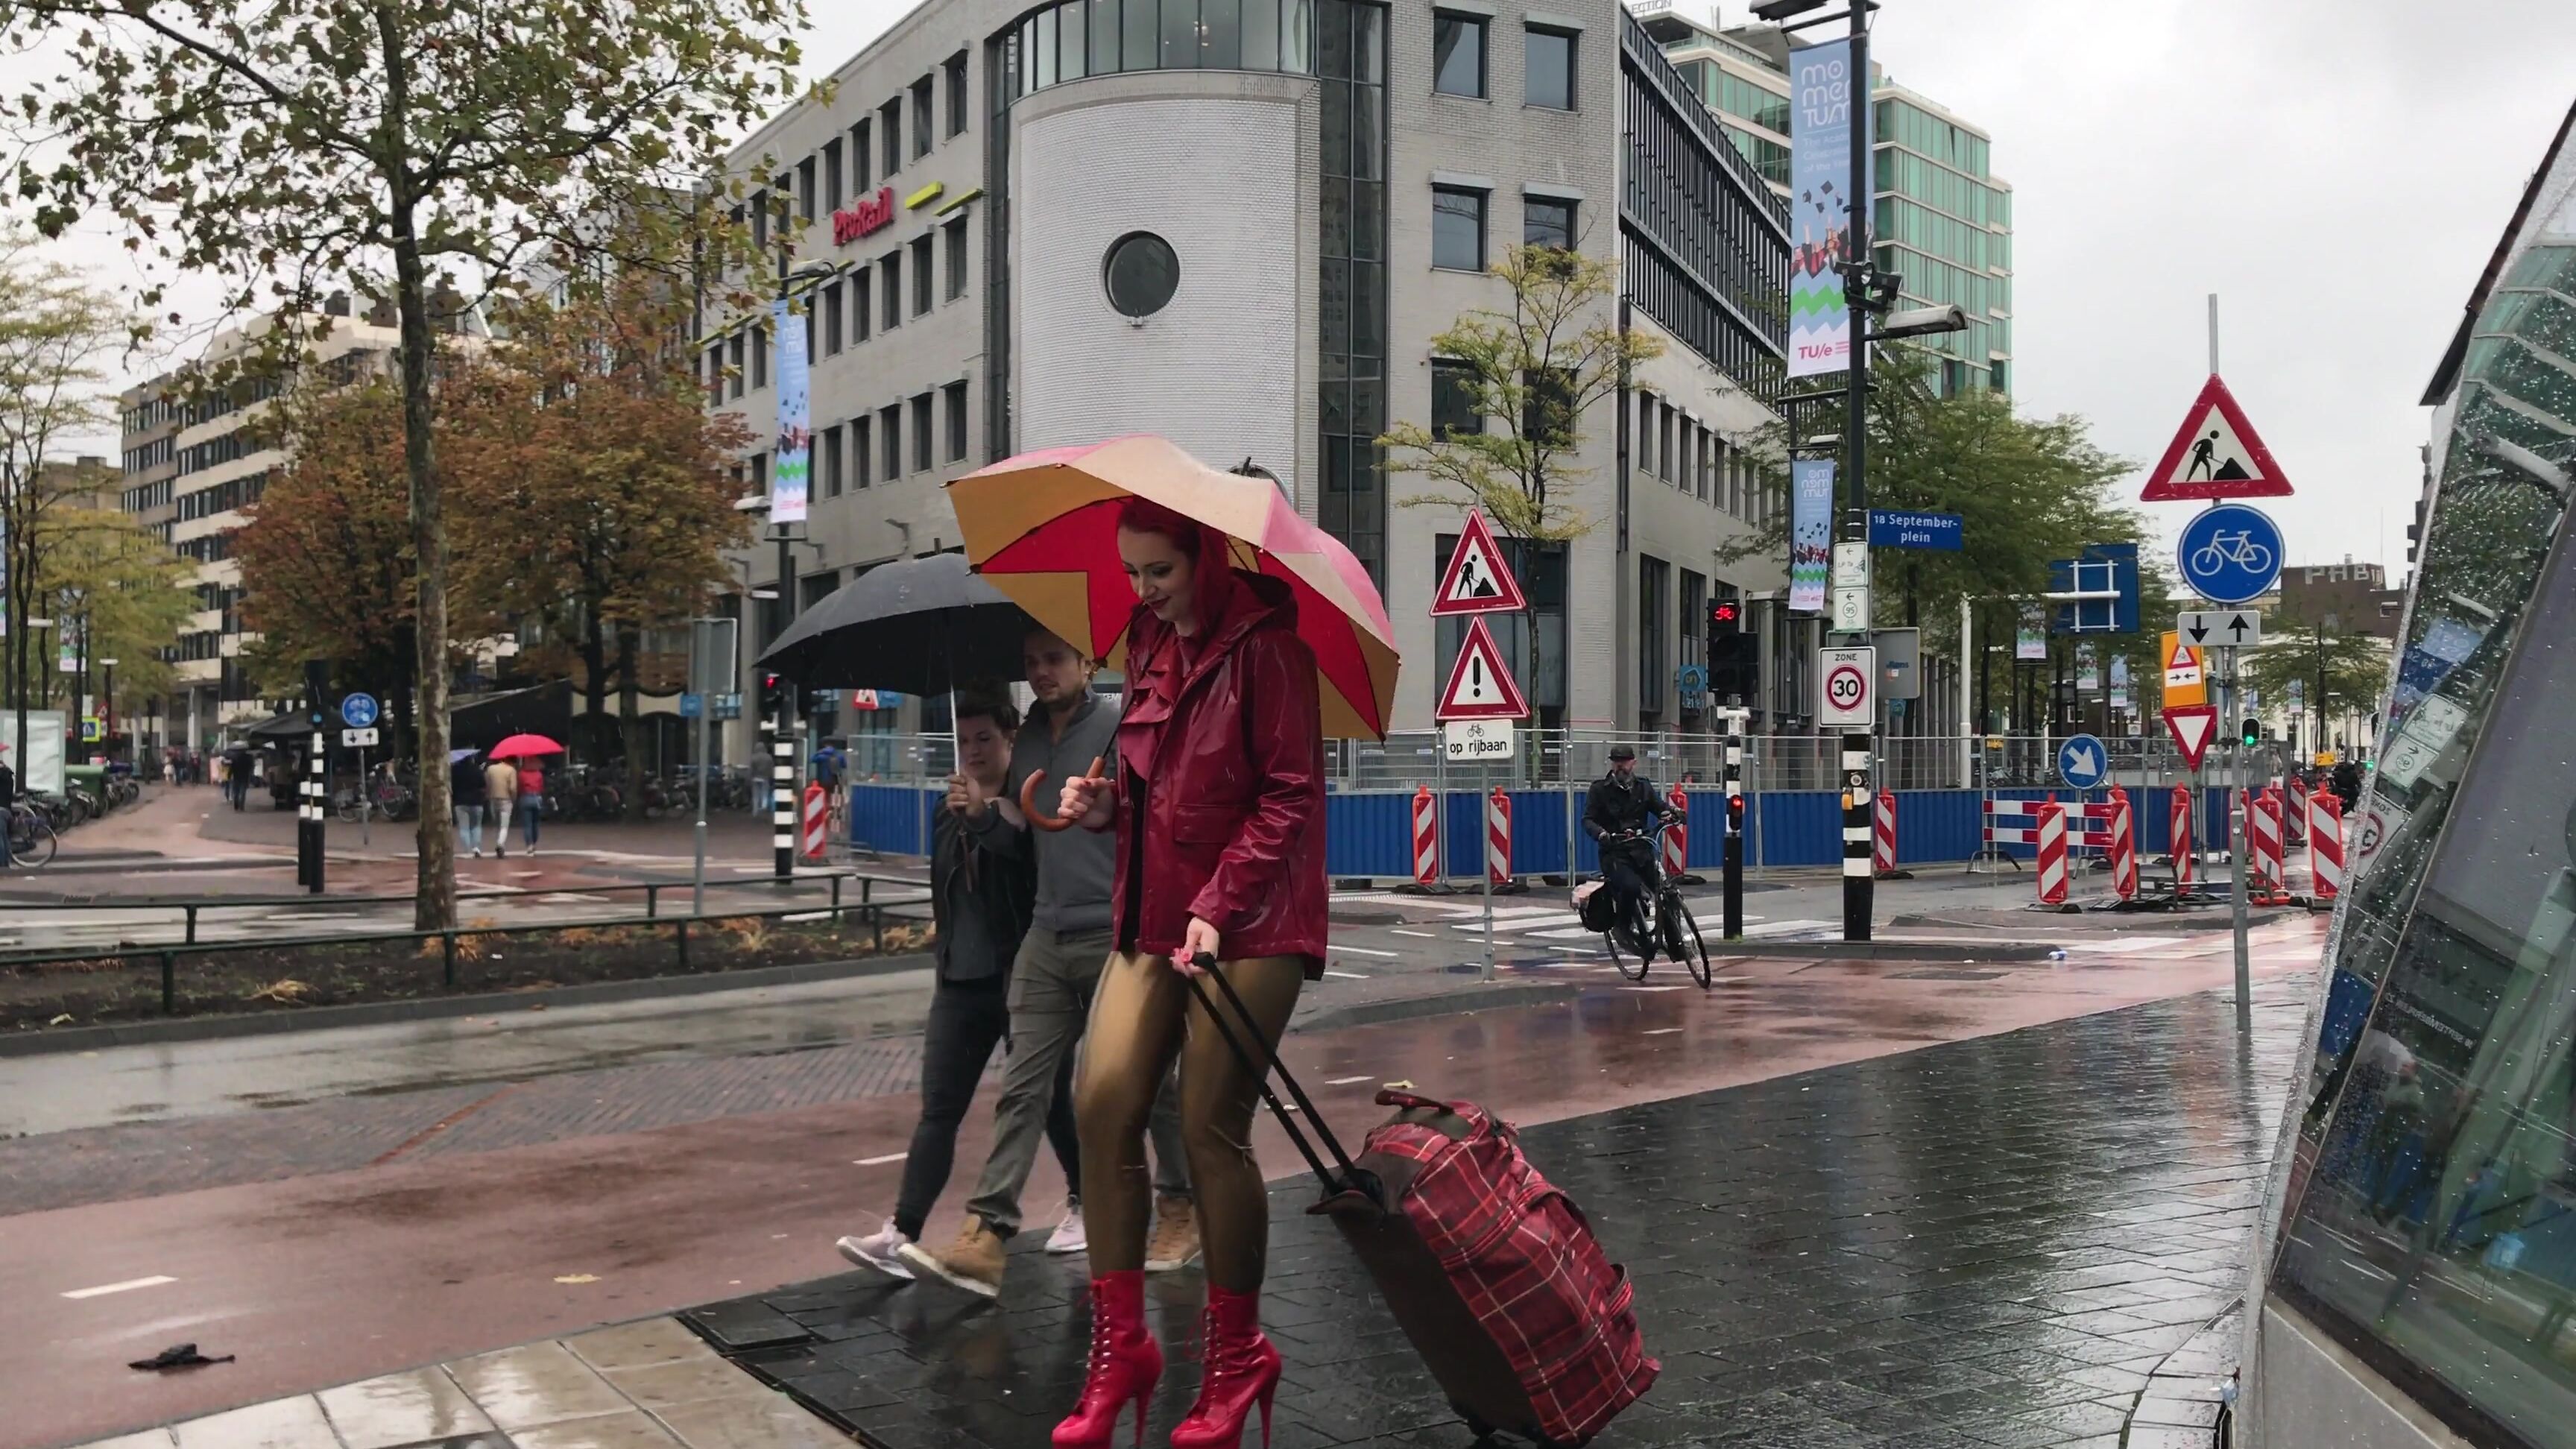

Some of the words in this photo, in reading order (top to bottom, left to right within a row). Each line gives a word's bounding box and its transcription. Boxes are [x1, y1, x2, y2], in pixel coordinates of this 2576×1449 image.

[833, 186, 892, 246] ProRail
[1798, 343, 1833, 359] TU/e
[1874, 514, 1885, 524] 18
[1889, 514, 1958, 528] September-
[1901, 530, 1931, 544] plein
[1833, 679, 1858, 697] 30
[1450, 743, 1462, 755] op
[1468, 739, 1507, 756] rijbaan
